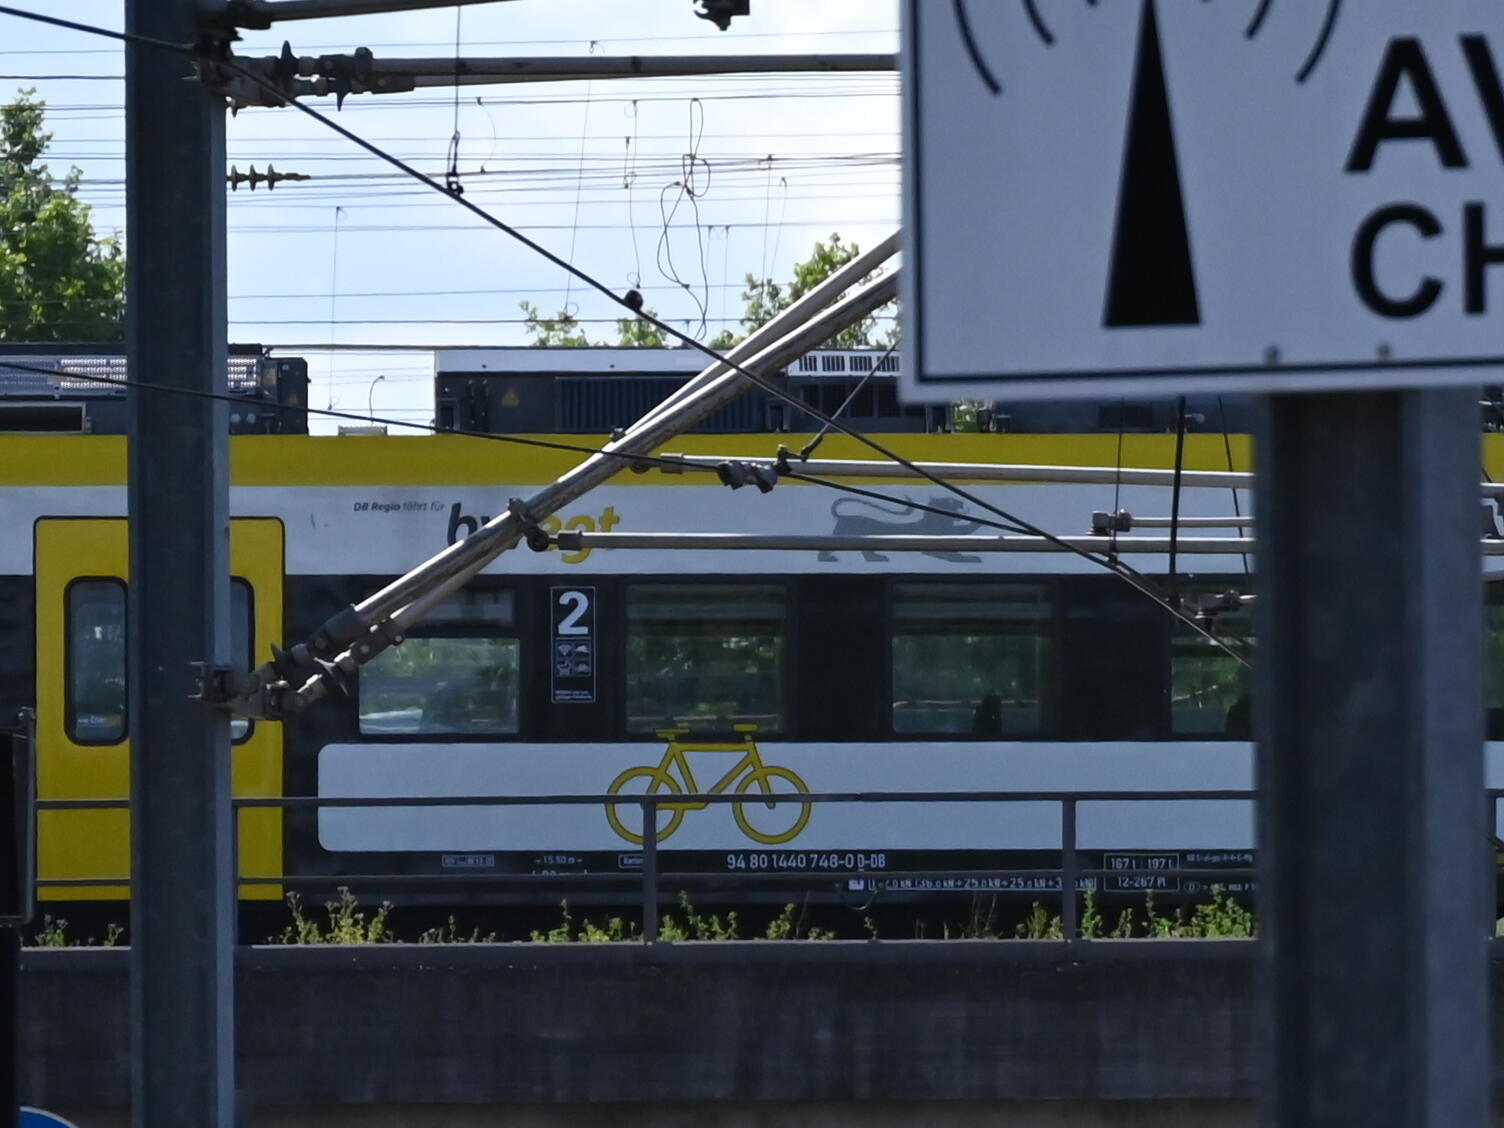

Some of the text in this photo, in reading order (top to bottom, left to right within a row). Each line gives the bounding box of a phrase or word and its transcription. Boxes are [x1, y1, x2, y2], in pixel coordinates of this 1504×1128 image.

[353, 502, 369, 511] DB
[371, 502, 400, 512] Regio
[558, 591, 588, 634] 2
[727, 854, 745, 869] 94
[750, 854, 768, 869] 80
[772, 854, 805, 868] 1440
[810, 854, 854, 868] 748-0
[1111, 858, 1129, 869] 167
[1148, 858, 1165, 869] 197
